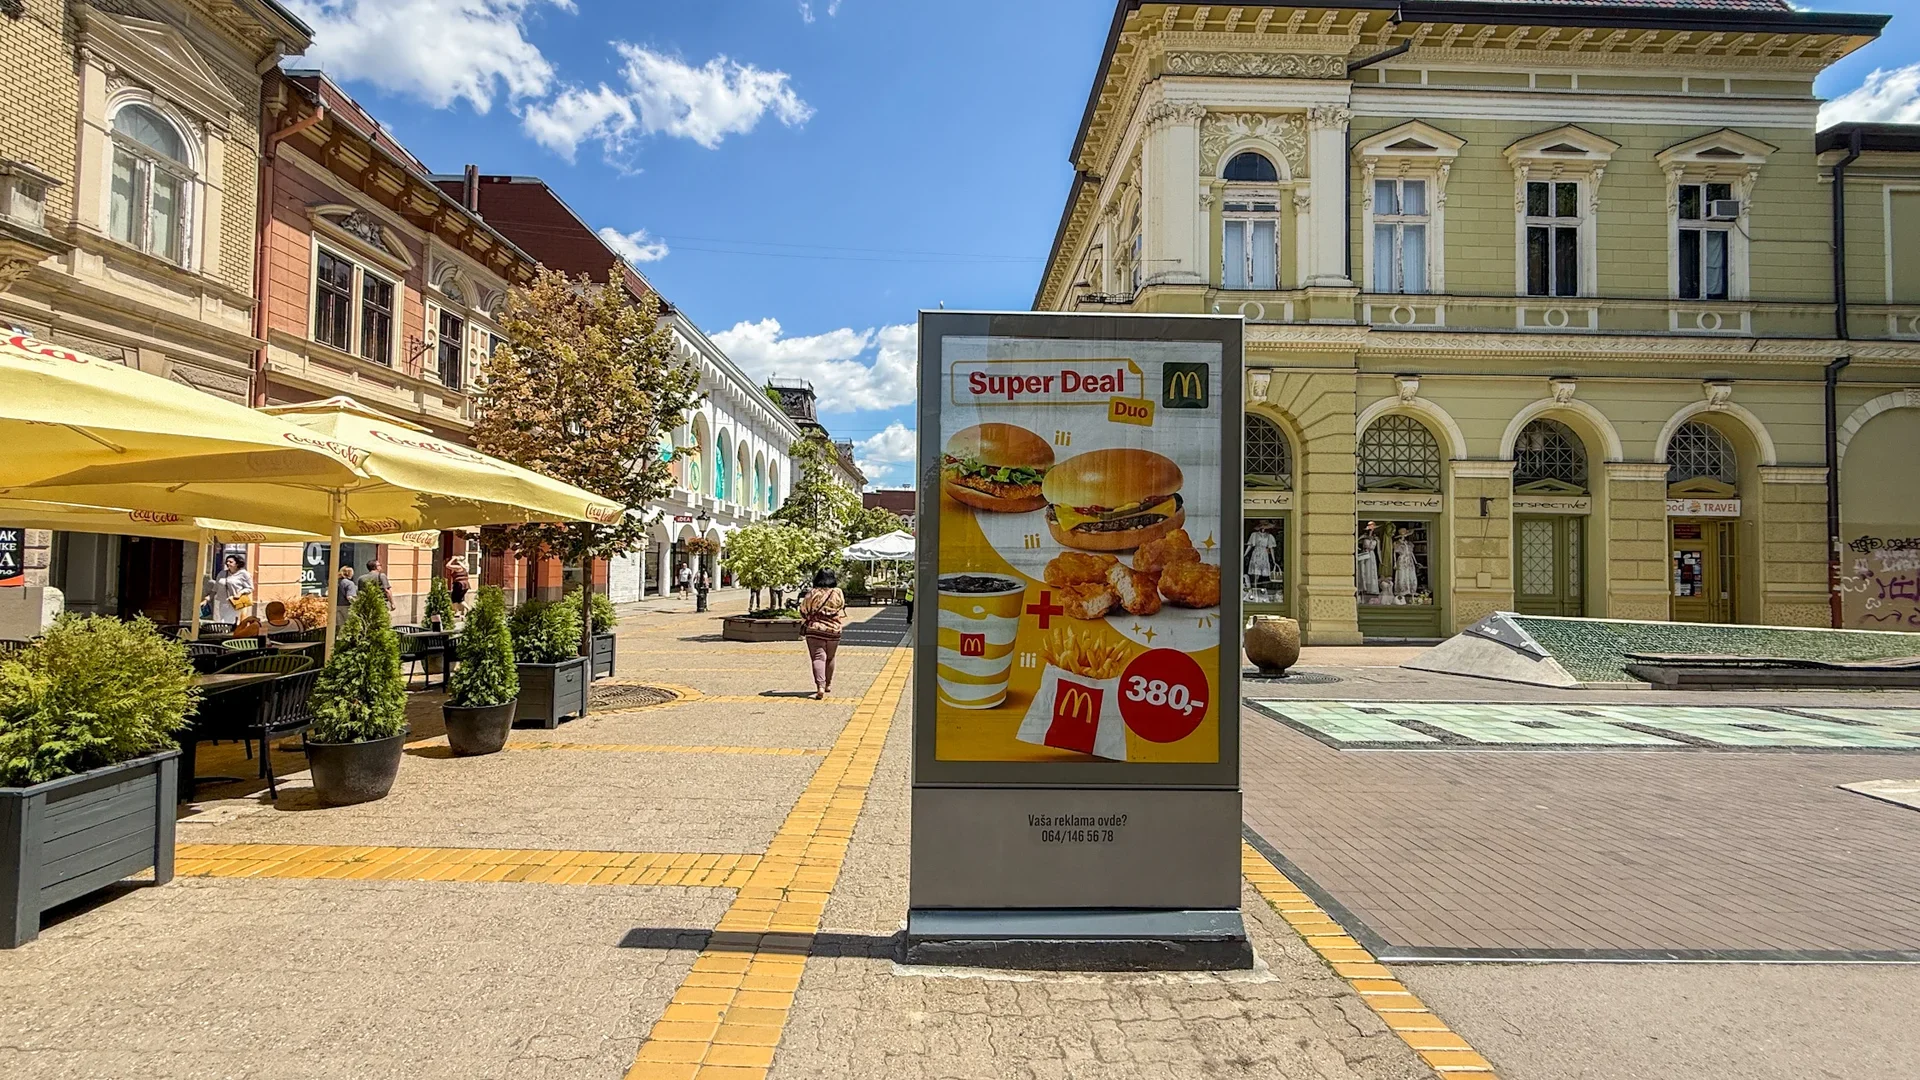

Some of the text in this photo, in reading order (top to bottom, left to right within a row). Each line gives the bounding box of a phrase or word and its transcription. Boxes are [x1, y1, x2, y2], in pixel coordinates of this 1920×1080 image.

[968, 369, 1124, 400] Super Deal
[1114, 402, 1148, 418] Duo
[1054, 430, 1071, 446] ili
[1704, 503, 1737, 512] TRAVEL
[1024, 533, 1040, 549] ili
[1020, 652, 1036, 668] ili
[1028, 814, 1128, 827] Vaša reklama ovde?
[1041, 830, 1114, 843] 064/146 56 78
